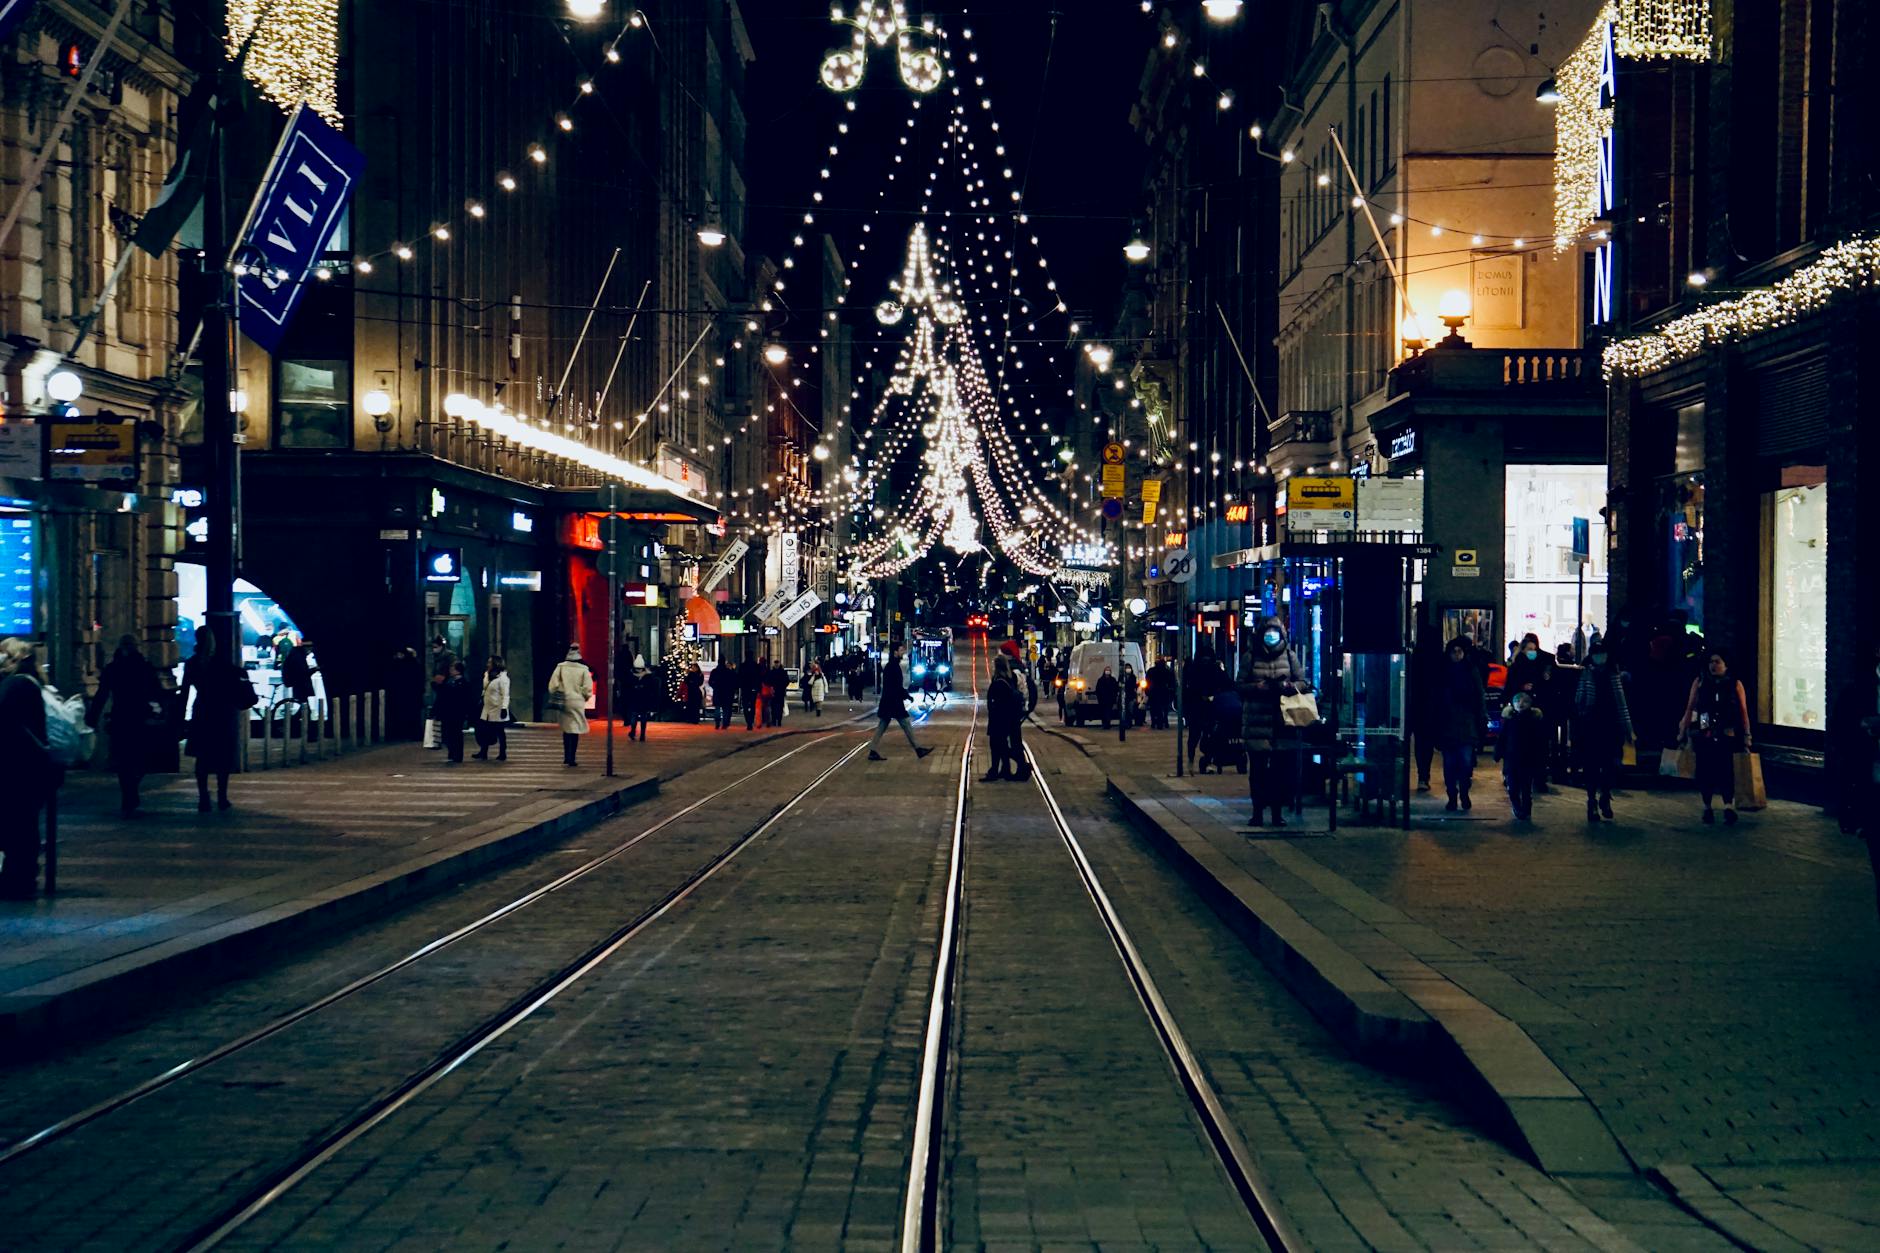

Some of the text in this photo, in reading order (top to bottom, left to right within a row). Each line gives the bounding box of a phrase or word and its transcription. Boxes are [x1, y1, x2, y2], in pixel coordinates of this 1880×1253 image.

[1478, 271, 1512, 280] DOMUS
[1477, 287, 1513, 296] LITONII
[1170, 558, 1190, 575] 20
